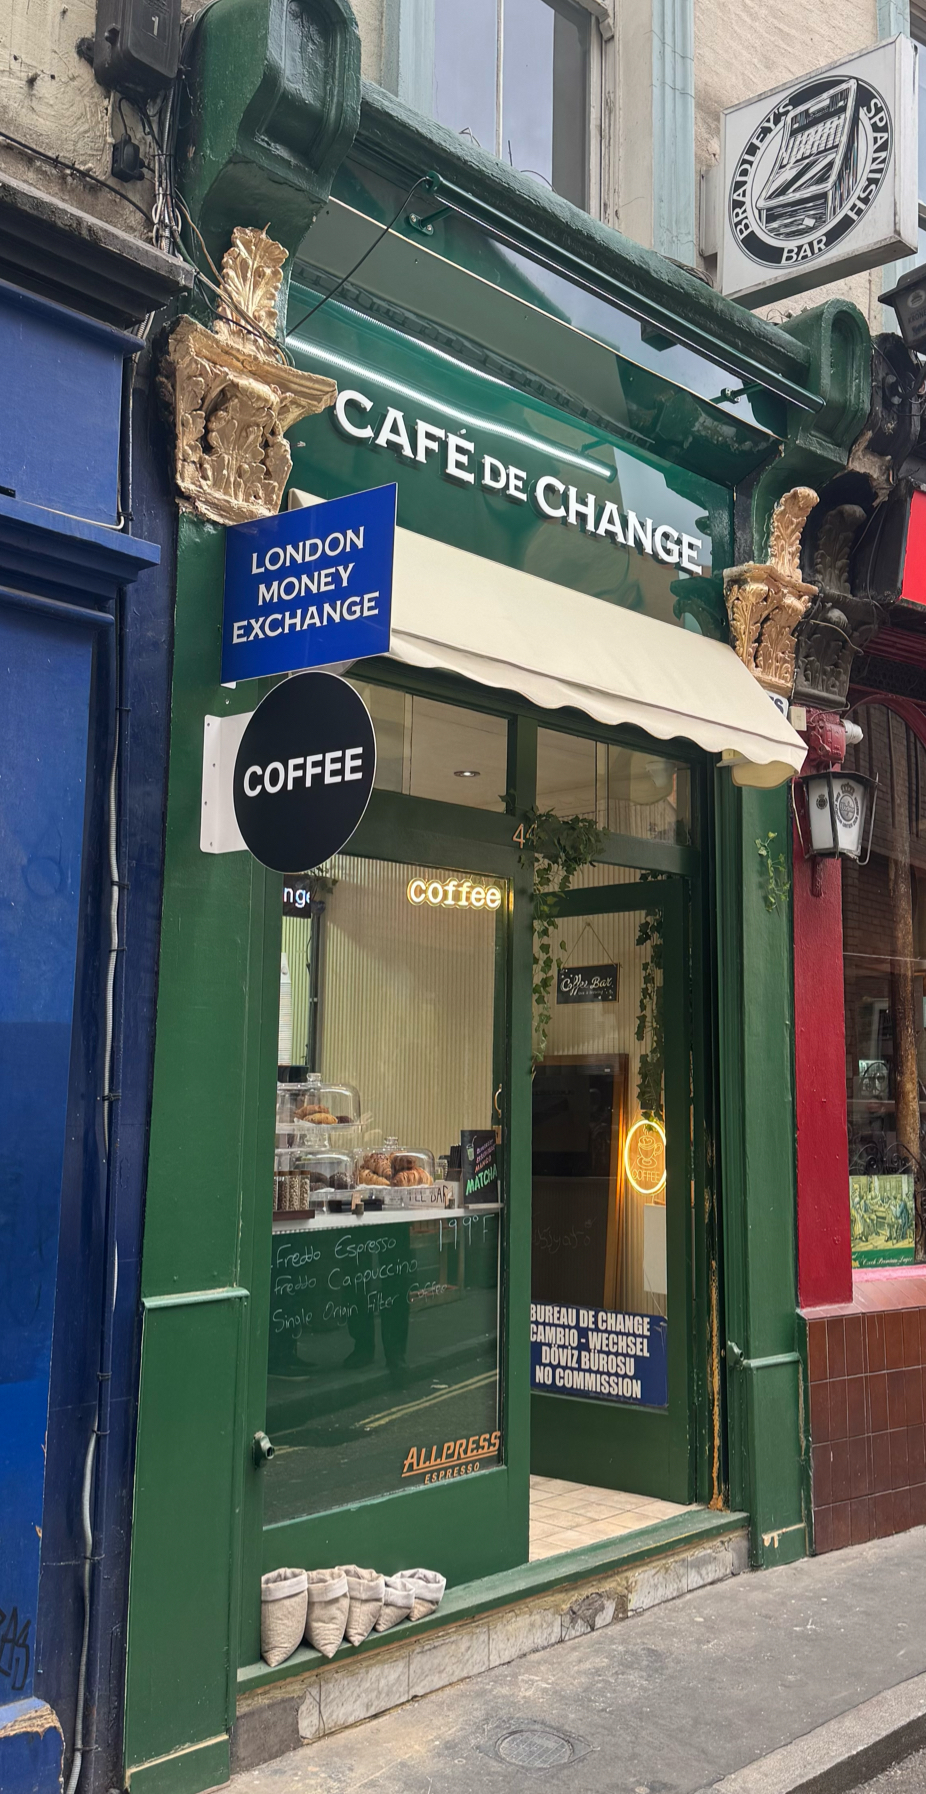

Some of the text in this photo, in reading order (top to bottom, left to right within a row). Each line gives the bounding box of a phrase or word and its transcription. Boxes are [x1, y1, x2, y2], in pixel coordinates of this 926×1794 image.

[151, 15, 159, 37] 1
[732, 99, 794, 240] BRADLEY'S
[846, 97, 889, 222] SPANISH
[780, 234, 828, 265] BAR
[334, 389, 703, 576] CAFÉ DE CHANGE
[251, 525, 365, 575] LONDON
[257, 562, 356, 607] MONEY
[231, 590, 380, 645] EXCHANGE
[243, 746, 364, 798] COFFEE
[409, 879, 502, 909] coffee
[560, 973, 613, 996] Coffee Bar
[465, 1163, 498, 1196] MATCHA
[631, 1168, 661, 1183] COFFEE
[276, 1235, 397, 1268] Freddo Espresso
[273, 1259, 418, 1296] Freddo Cappuccino
[272, 1281, 448, 1339] Single Origin Filter Coffee
[530, 1303, 651, 1336] BUREAU DE CHANGE
[530, 1323, 579, 1348] CAMBIO
[587, 1330, 650, 1358] WECHSEL
[580, 1349, 635, 1377] BÜROSU
[535, 1365, 642, 1399] NO COMMISSION
[402, 1430, 501, 1473] ALLPRESS
[424, 1461, 480, 1486] ESPRESSO
